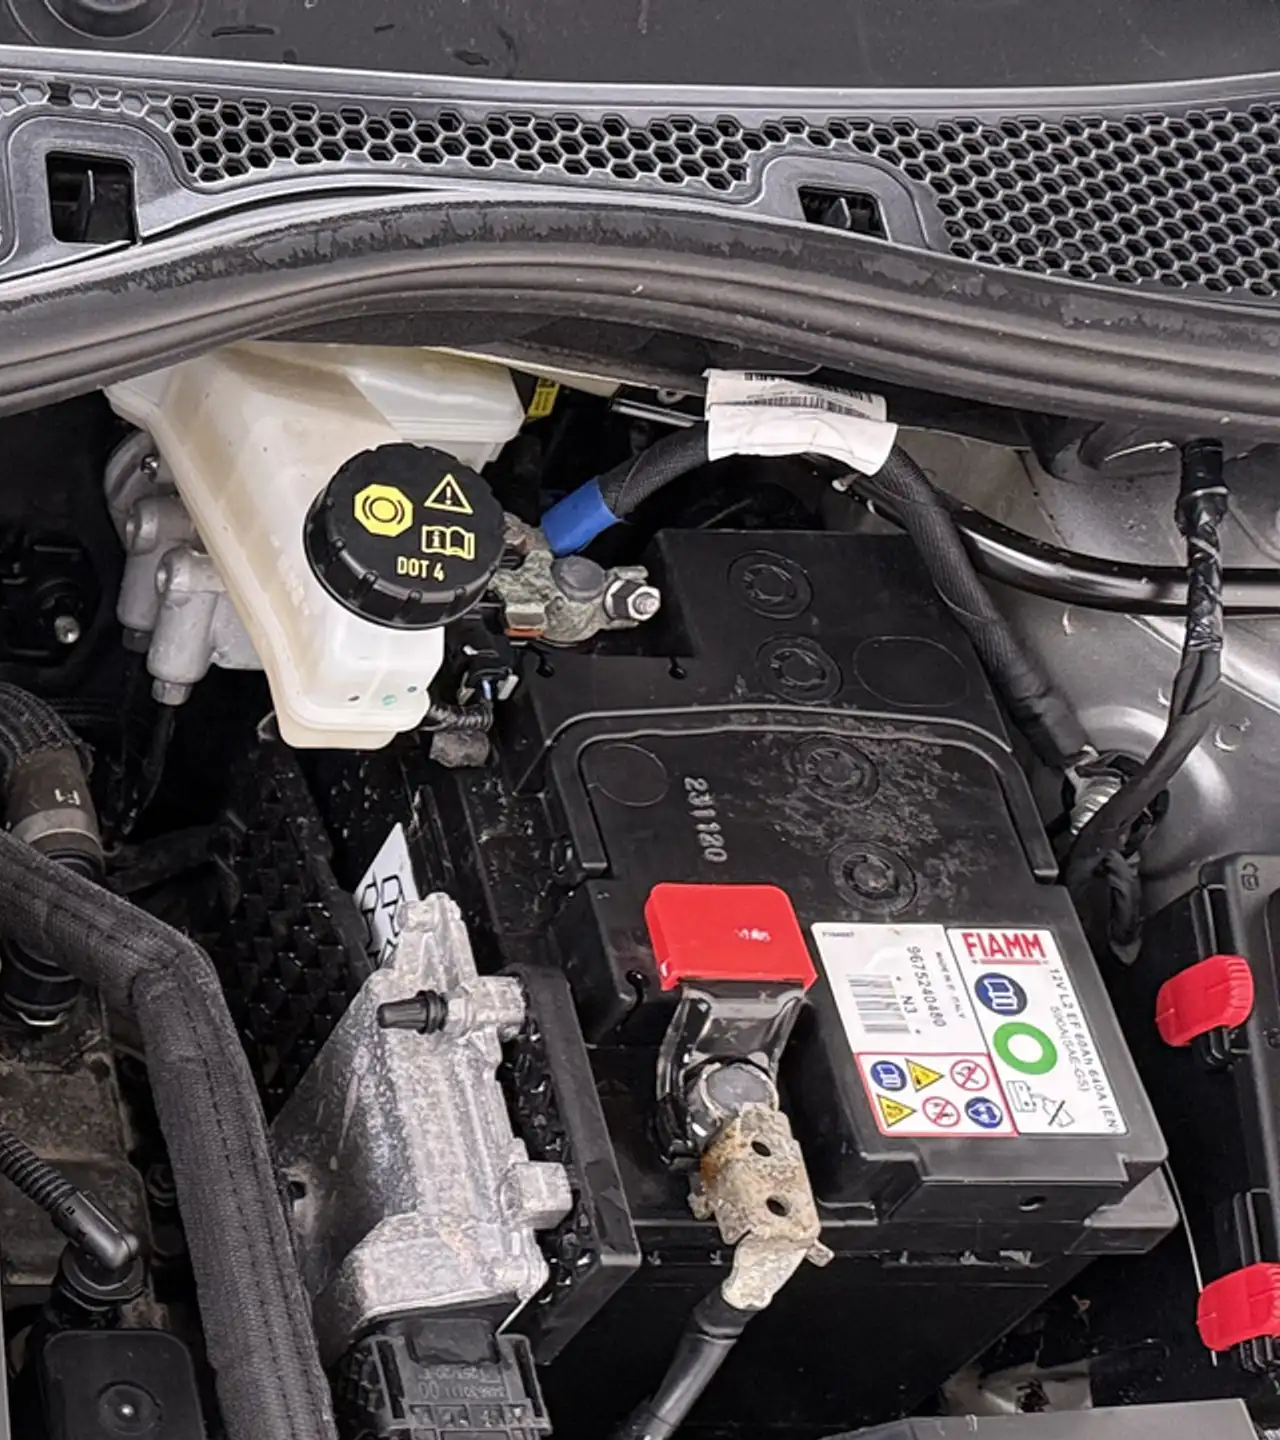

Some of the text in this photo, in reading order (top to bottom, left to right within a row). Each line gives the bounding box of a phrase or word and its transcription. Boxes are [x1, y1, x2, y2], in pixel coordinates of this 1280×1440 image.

[397, 555, 445, 581] DOT 4
[683, 777, 728, 862] 231120
[961, 932, 1048, 958] FIAMM
[1049, 968, 1068, 992] 12V
